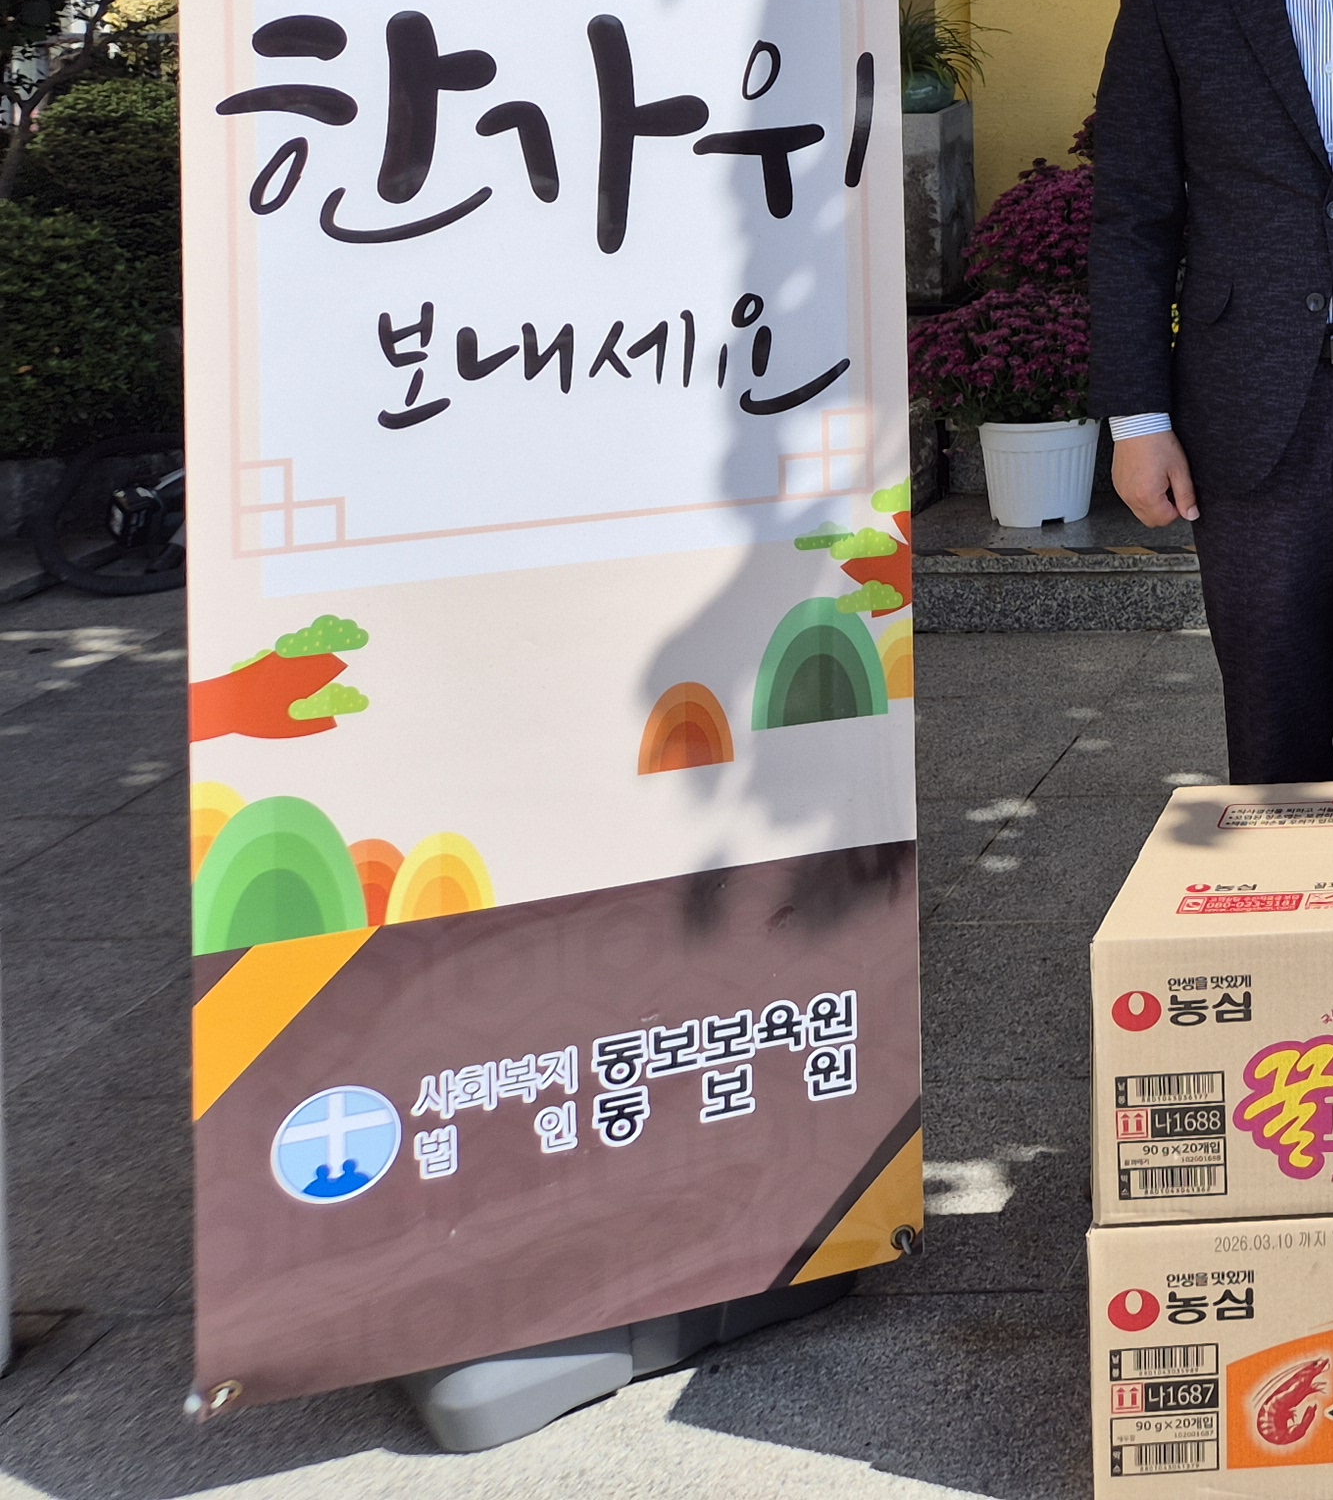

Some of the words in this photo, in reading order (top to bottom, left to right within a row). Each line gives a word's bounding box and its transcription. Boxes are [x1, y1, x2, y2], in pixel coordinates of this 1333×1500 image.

[215, 10, 874, 255] 한가위
[378, 292, 850, 430] 보내세요
[1215, 883, 1257, 891] 농심
[1168, 977, 1208, 992] 인생을
[1211, 975, 1252, 990] 맛있게
[1168, 990, 1252, 1027] 농심
[411, 1050, 577, 1119] 사회복지
[594, 990, 857, 1088] 동보보육원
[1155, 1110, 1221, 1135] 나1688
[1214, 1233, 1293, 1253] 2026.03.10
[1298, 1231, 1327, 1248] 까지
[1166, 1272, 1208, 1288] 인생을
[1211, 1269, 1255, 1286] 맛있게
[1165, 1287, 1254, 1325] 농심
[1148, 1383, 1215, 1409] 나1687
